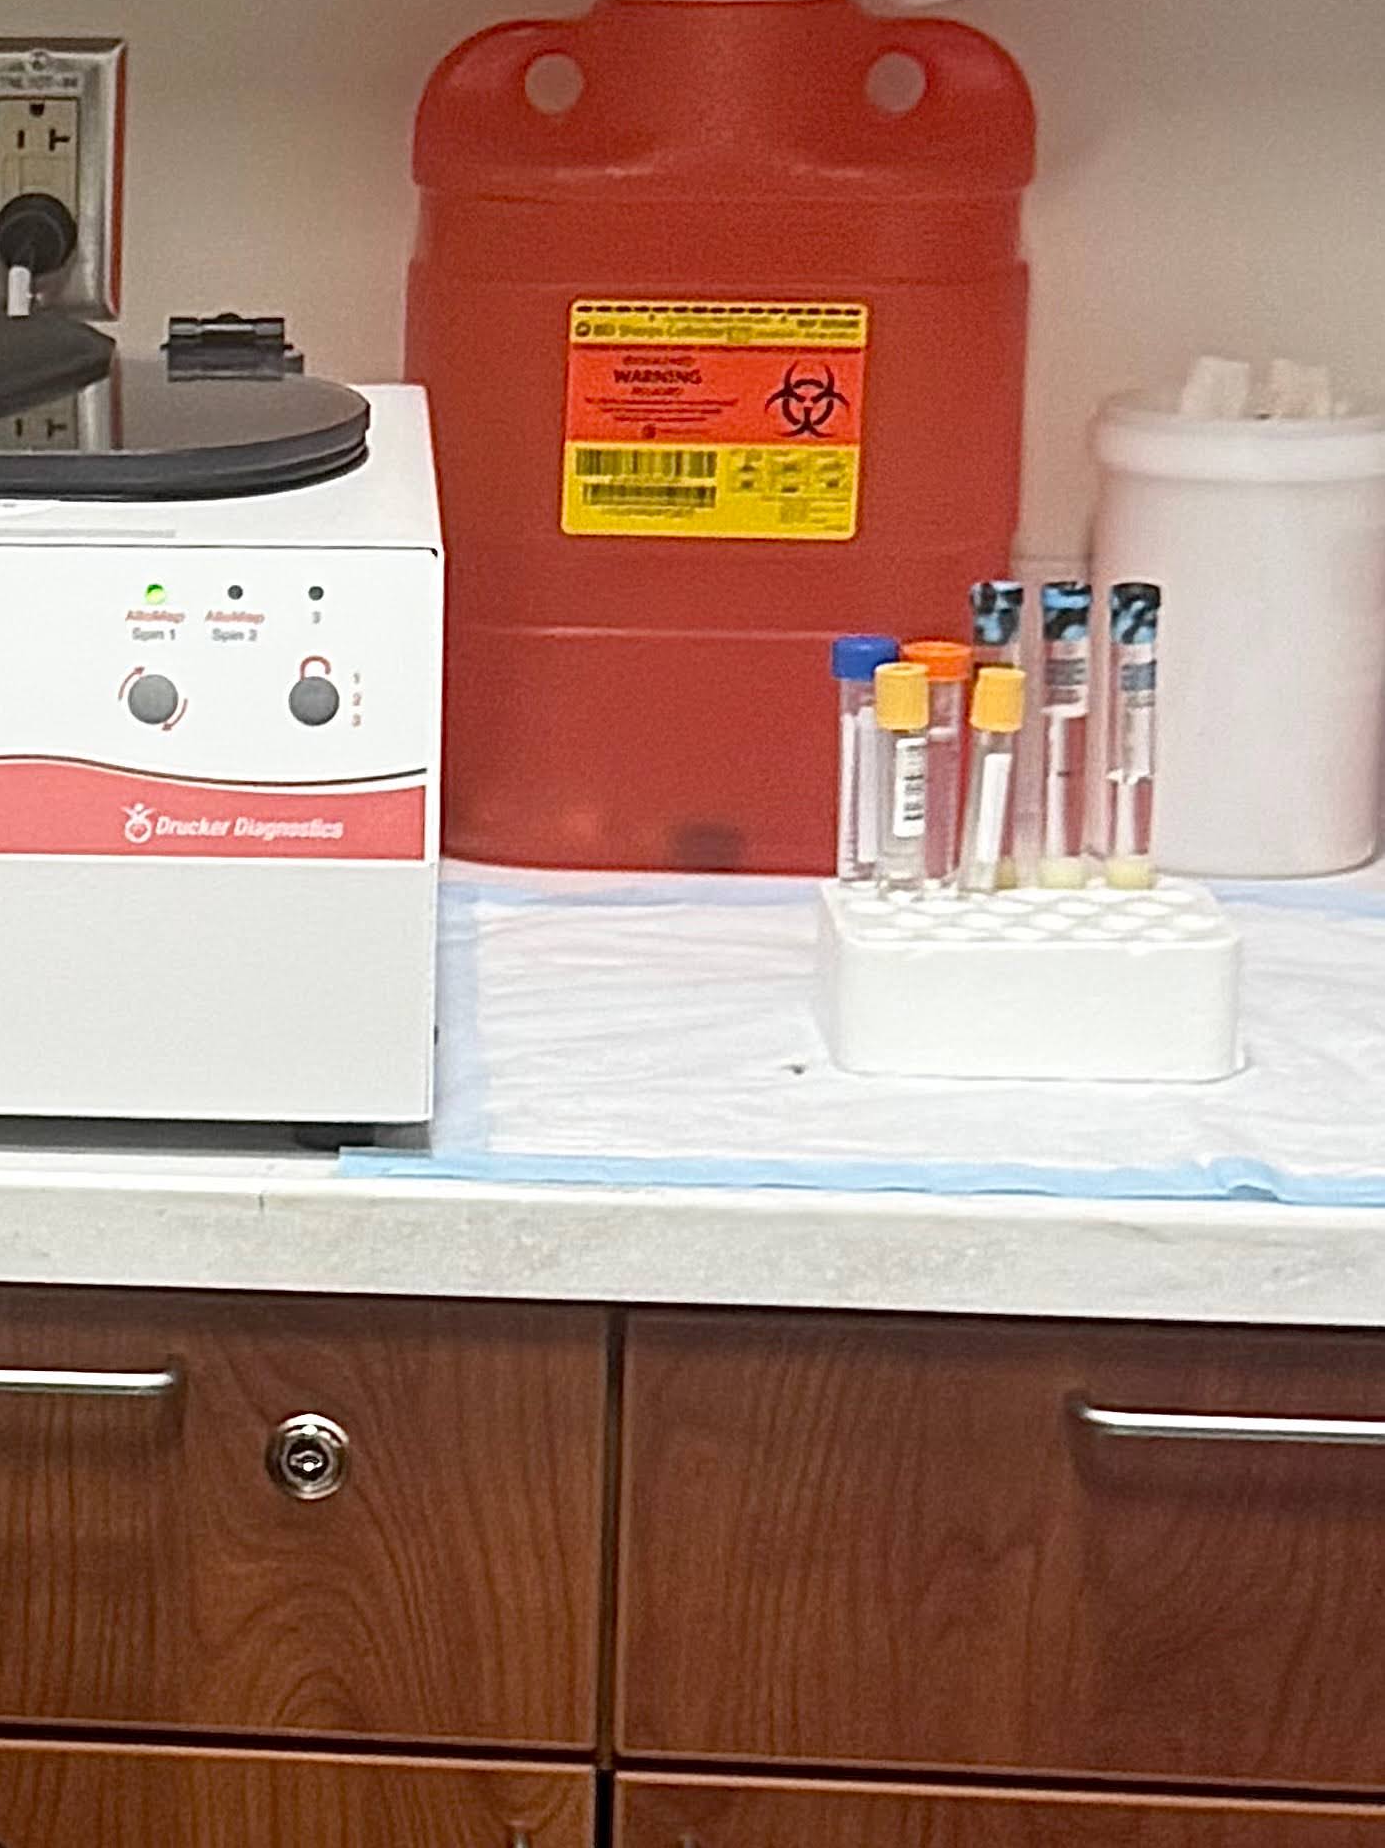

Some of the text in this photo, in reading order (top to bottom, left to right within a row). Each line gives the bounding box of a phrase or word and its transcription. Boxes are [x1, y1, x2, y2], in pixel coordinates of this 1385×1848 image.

[613, 369, 703, 385] WARNING
[131, 627, 164, 642] Spin
[211, 628, 244, 642] Spin
[155, 816, 345, 841] Drucker Diagnostics
